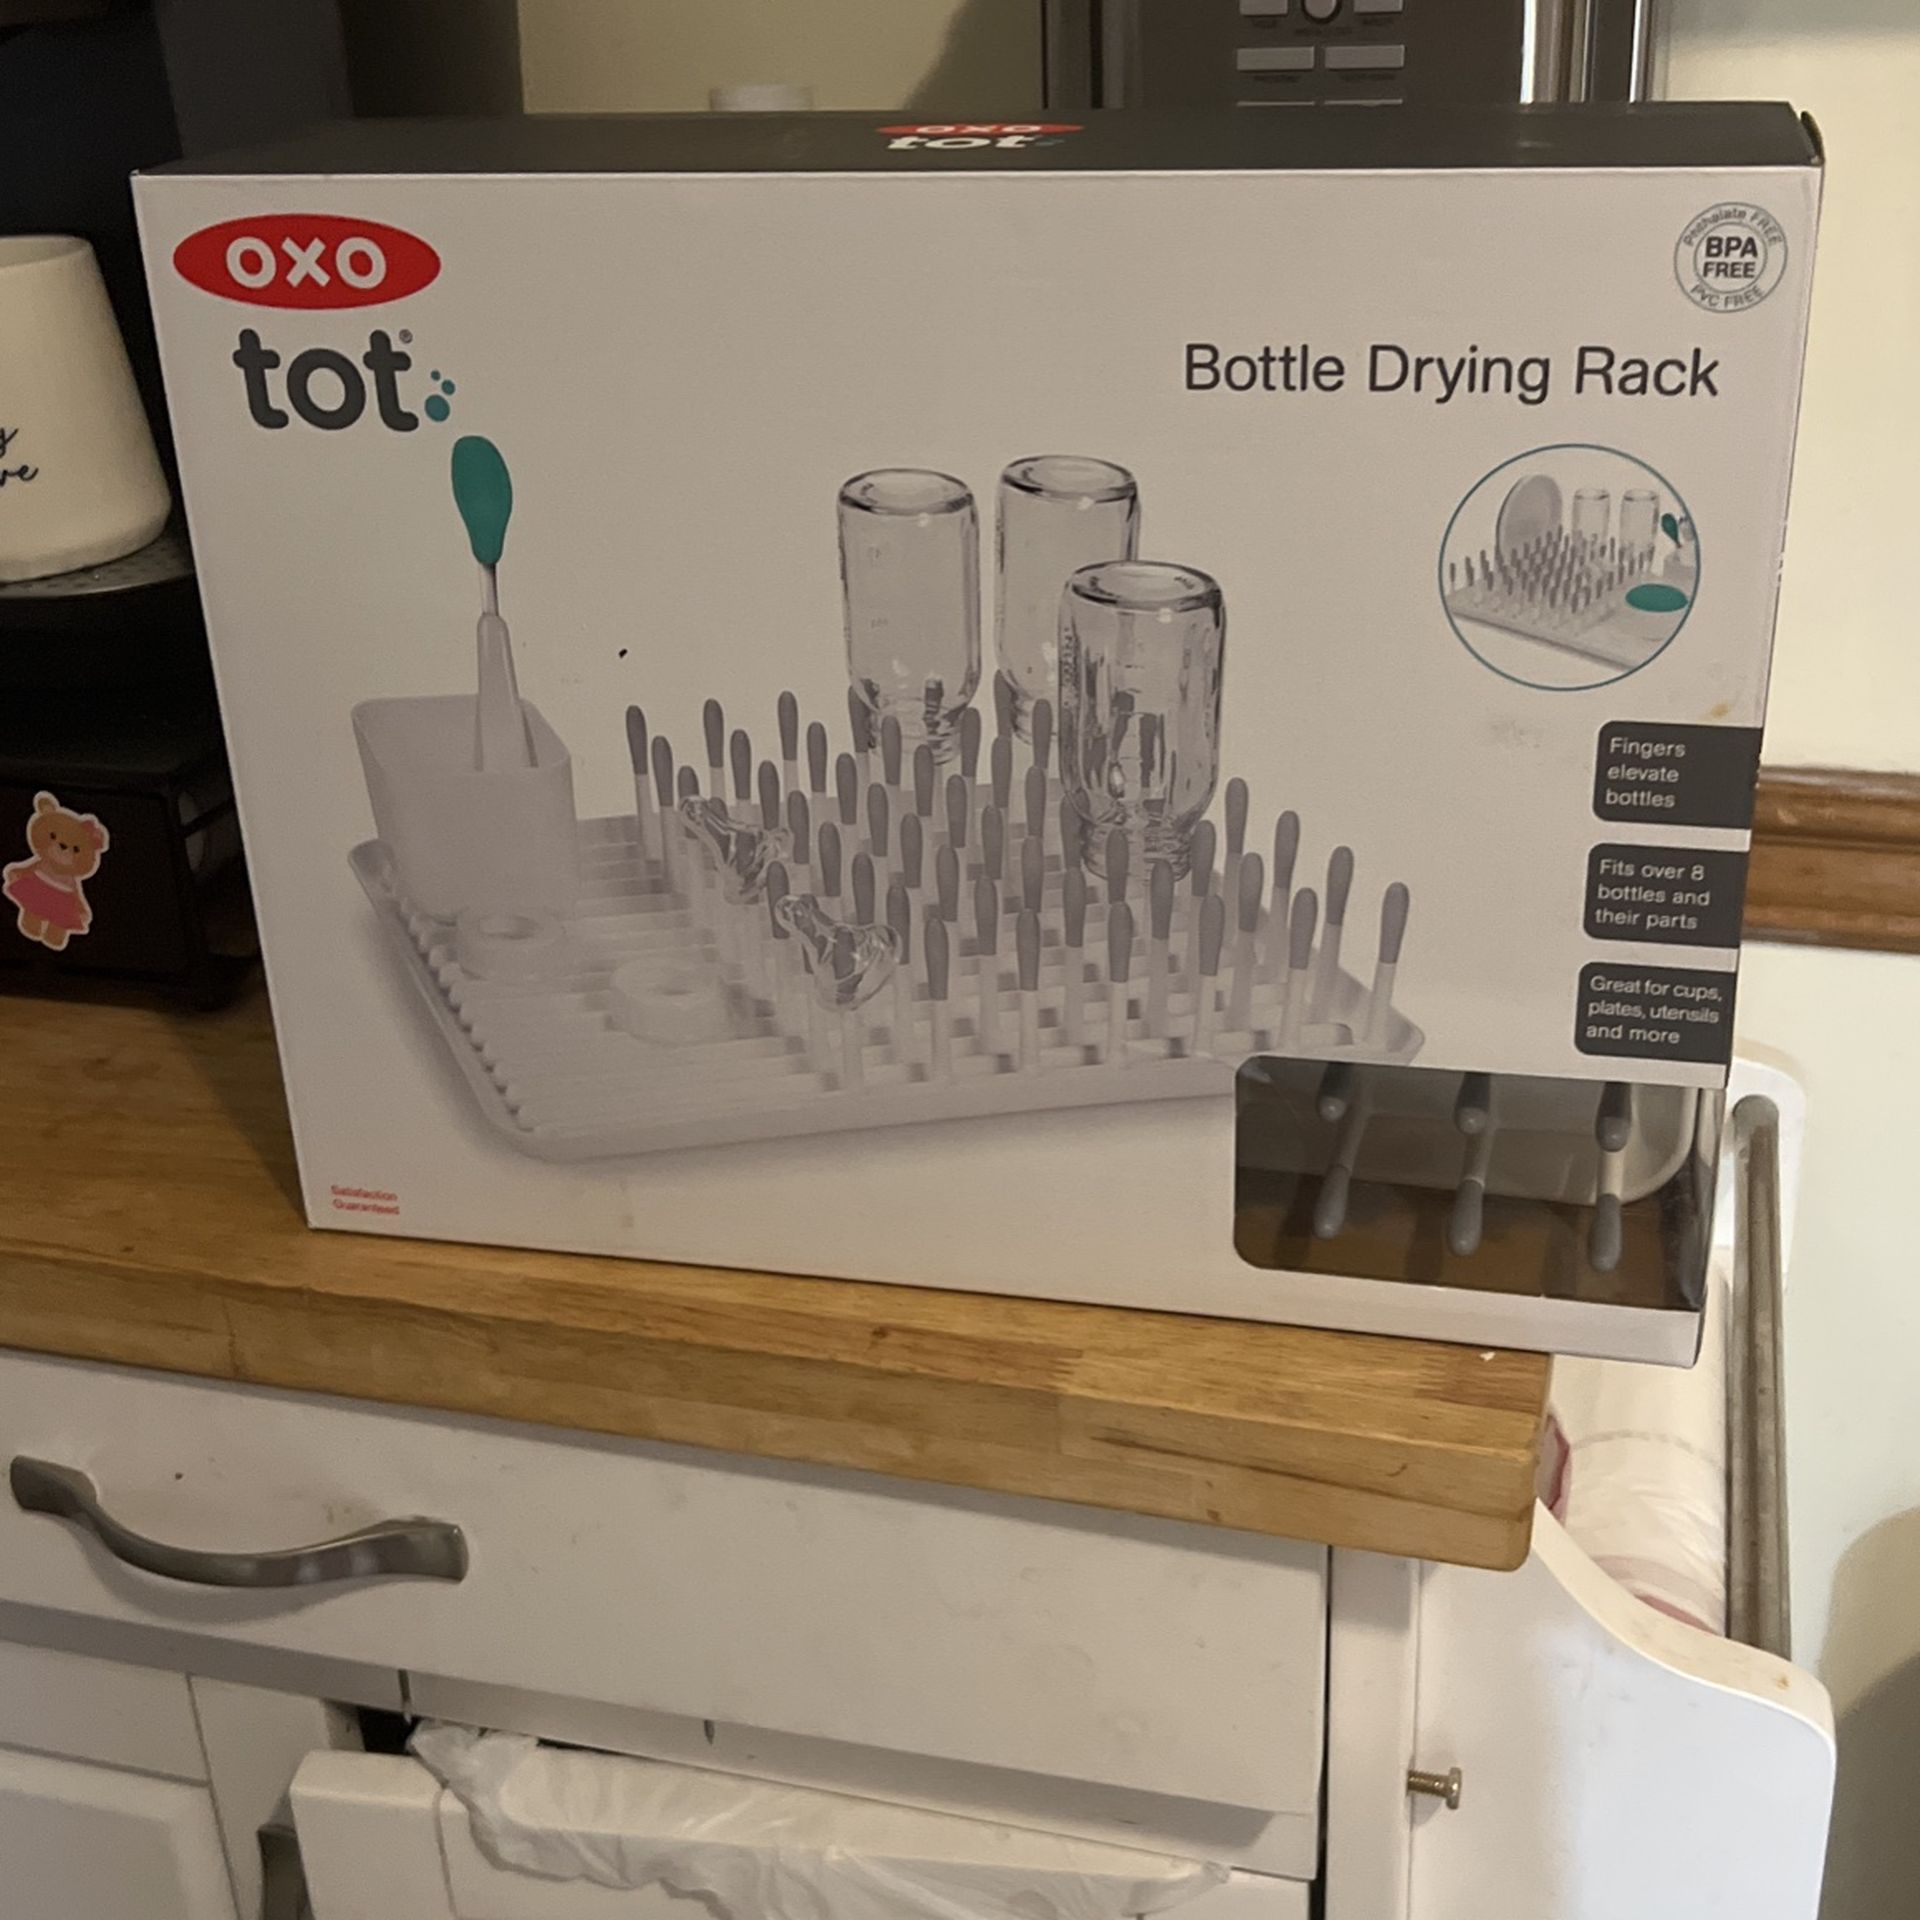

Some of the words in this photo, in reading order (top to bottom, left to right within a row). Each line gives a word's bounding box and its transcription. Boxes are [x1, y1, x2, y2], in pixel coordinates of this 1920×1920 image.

[915, 124, 1042, 134] OXO
[887, 135, 1036, 150] tot
[1705, 236, 1758, 258] BPA
[225, 236, 387, 290] OXO
[1703, 261, 1756, 279] FREE
[1690, 283, 1720, 307] PVC
[1724, 284, 1763, 308] FREE
[1185, 344, 1345, 392] Bottle
[1368, 344, 1550, 406] Drying
[1574, 346, 1721, 397] Rack
[1609, 737, 1686, 759] Fingers
[1607, 764, 1680, 783] elevate
[1605, 788, 1676, 808] bottles
[1600, 858, 1635, 877] Fits
[1641, 864, 1685, 879] over
[1690, 864, 1705, 881] 8
[1597, 884, 1666, 903] bottles
[1672, 891, 1711, 906] and
[1595, 909, 1640, 926] their
[1646, 913, 1698, 930] parts
[1590, 975, 1641, 994] Great
[1644, 980, 1670, 996] for
[1672, 984, 1723, 1003] cups,
[1588, 1001, 1646, 1020] plates,
[1650, 1005, 1720, 1024] utensils
[1586, 1025, 1623, 1040] and
[1629, 1028, 1681, 1044] more
